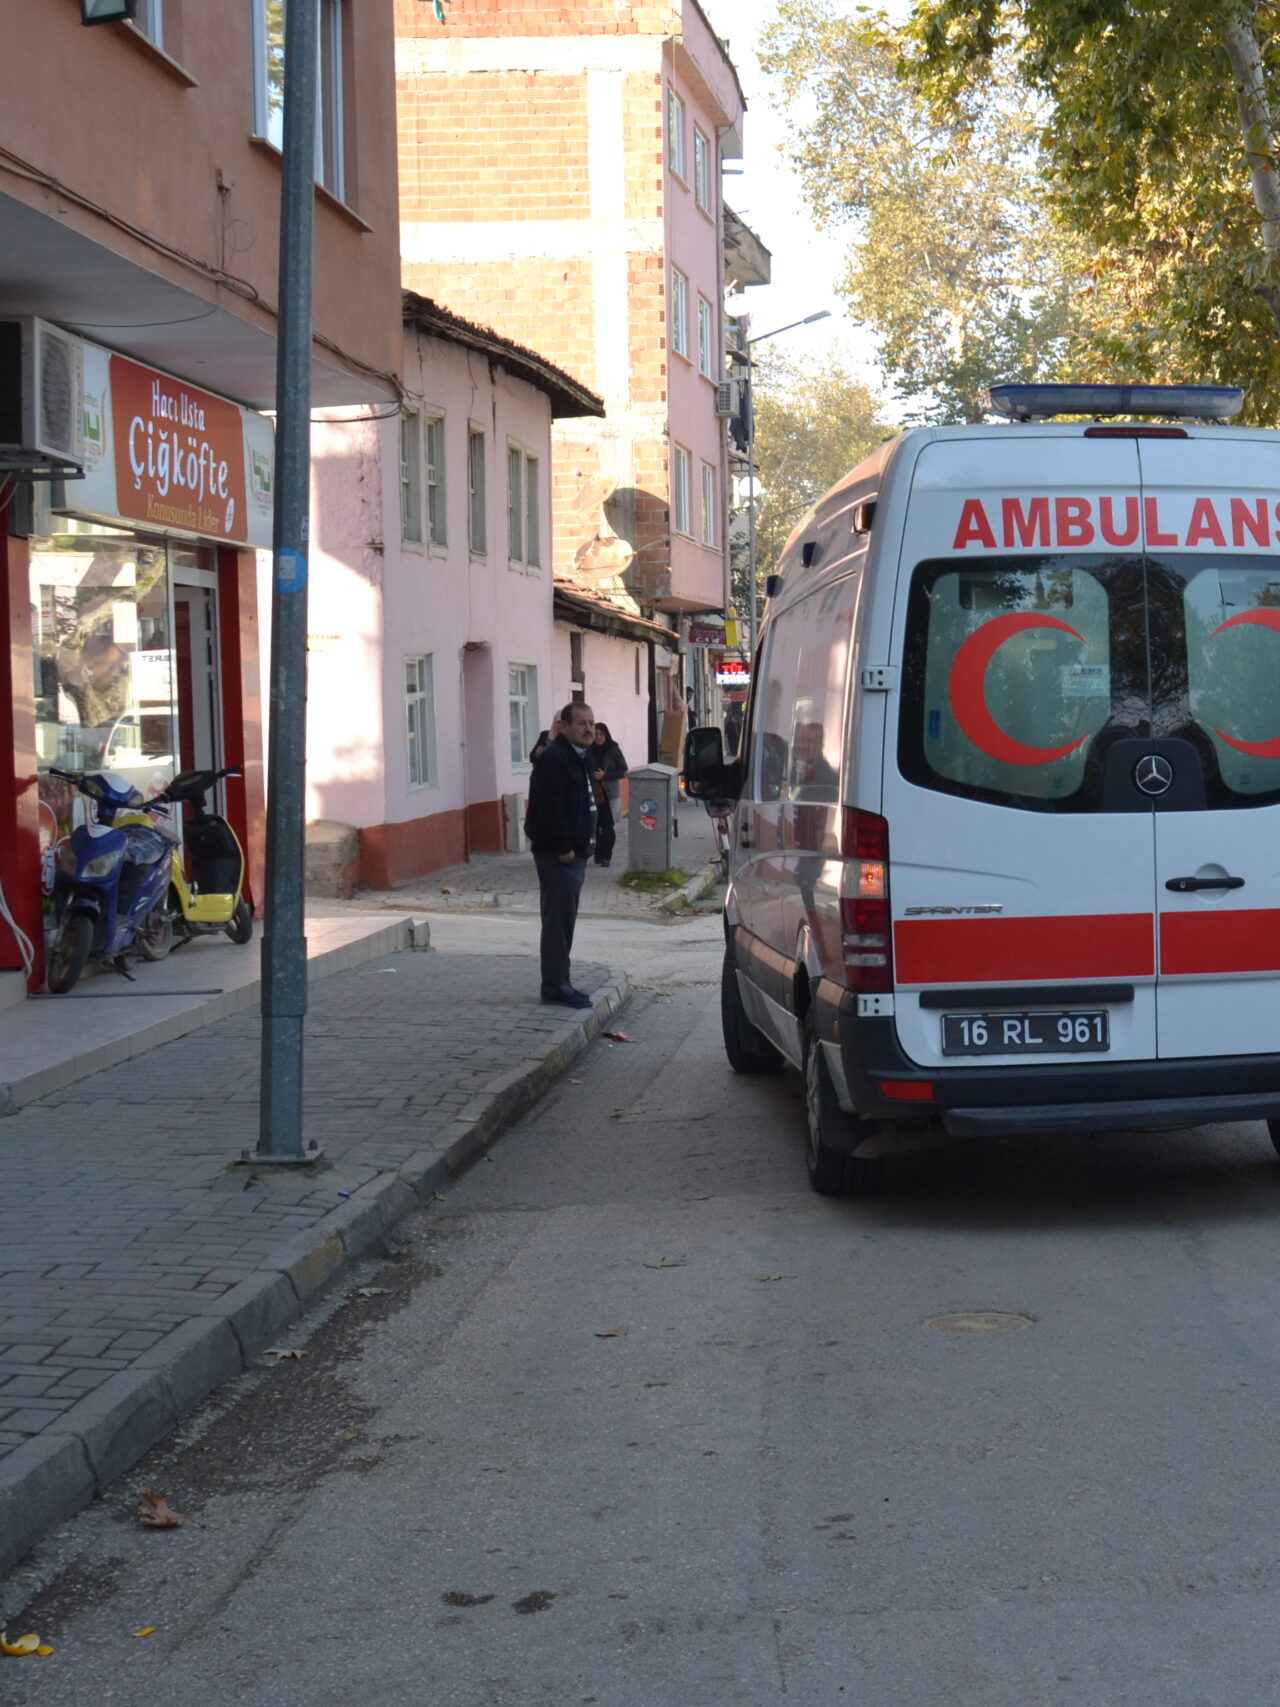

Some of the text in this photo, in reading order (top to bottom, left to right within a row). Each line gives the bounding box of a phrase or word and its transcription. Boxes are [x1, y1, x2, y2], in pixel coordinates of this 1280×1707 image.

[152, 379, 206, 432] Hacı Usta
[129, 415, 228, 502] Çiğköfte
[146, 493, 196, 528] Konusunda
[198, 506, 220, 533] Lider
[904, 904, 1003, 916] SPRINTER
[960, 1017, 1103, 1046] 16 RL 961
